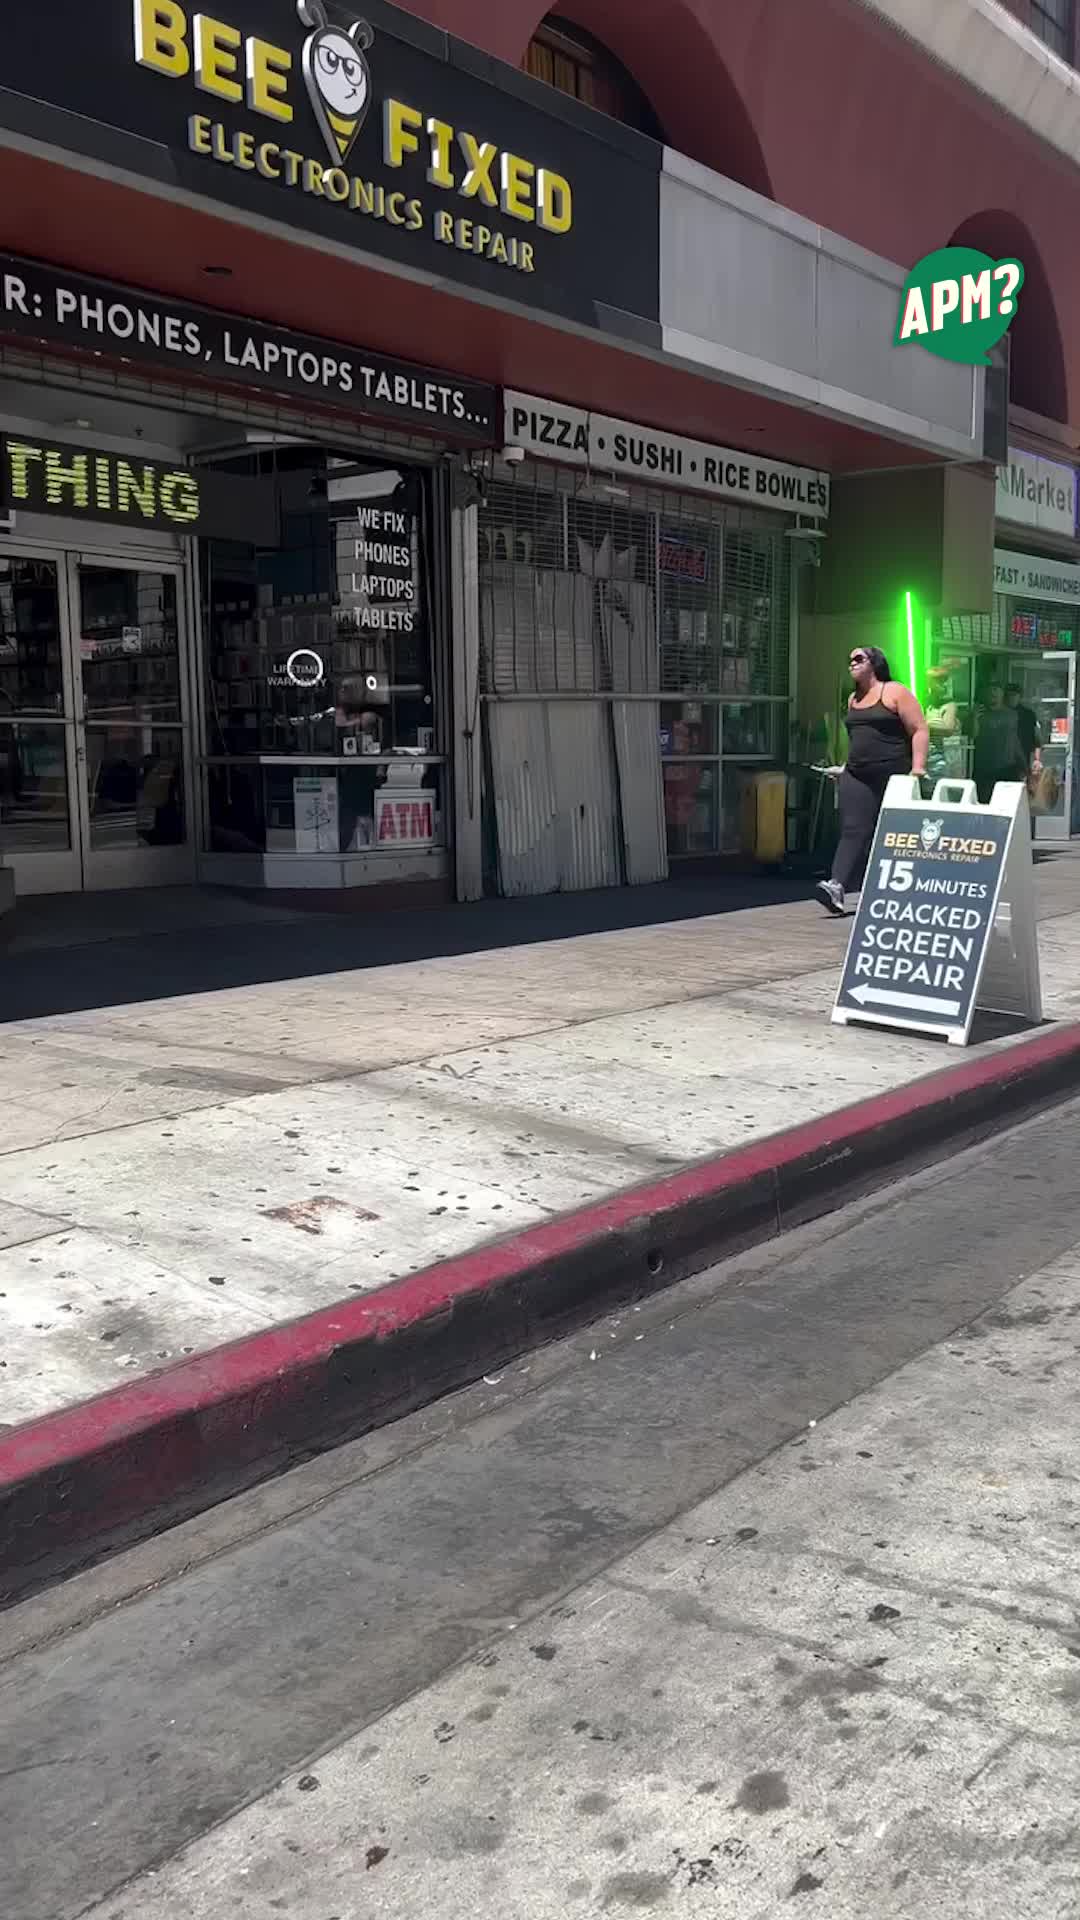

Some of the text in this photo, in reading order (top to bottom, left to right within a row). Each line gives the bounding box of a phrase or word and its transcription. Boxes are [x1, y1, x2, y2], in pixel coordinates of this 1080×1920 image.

[134, 0, 573, 234] BEE FIXED
[188, 114, 535, 272] ELECTRONICS REPAIR
[56, 288, 212, 361] PHONES,
[224, 331, 352, 392] LAPTOPS
[512, 407, 590, 452] PIZZA
[614, 435, 682, 475] SUSHI
[704, 458, 750, 490] RICE
[6, 440, 200, 523] THING
[357, 506, 405, 534] WE FIX
[355, 540, 409, 567] PHONES
[352, 573, 414, 600] LAPTOPS
[353, 606, 414, 632] TABLETS
[272, 664, 322, 675] LIFETIM
[379, 802, 433, 840] ATM
[884, 832, 997, 856] BEE FIXED
[893, 849, 980, 864] ELECTRONICS REPAIR
[878, 859, 988, 899] 15 MINUTES
[869, 899, 982, 931] CRACKED
[861, 924, 974, 962] SCREEN
[854, 952, 965, 991] REPAIR
